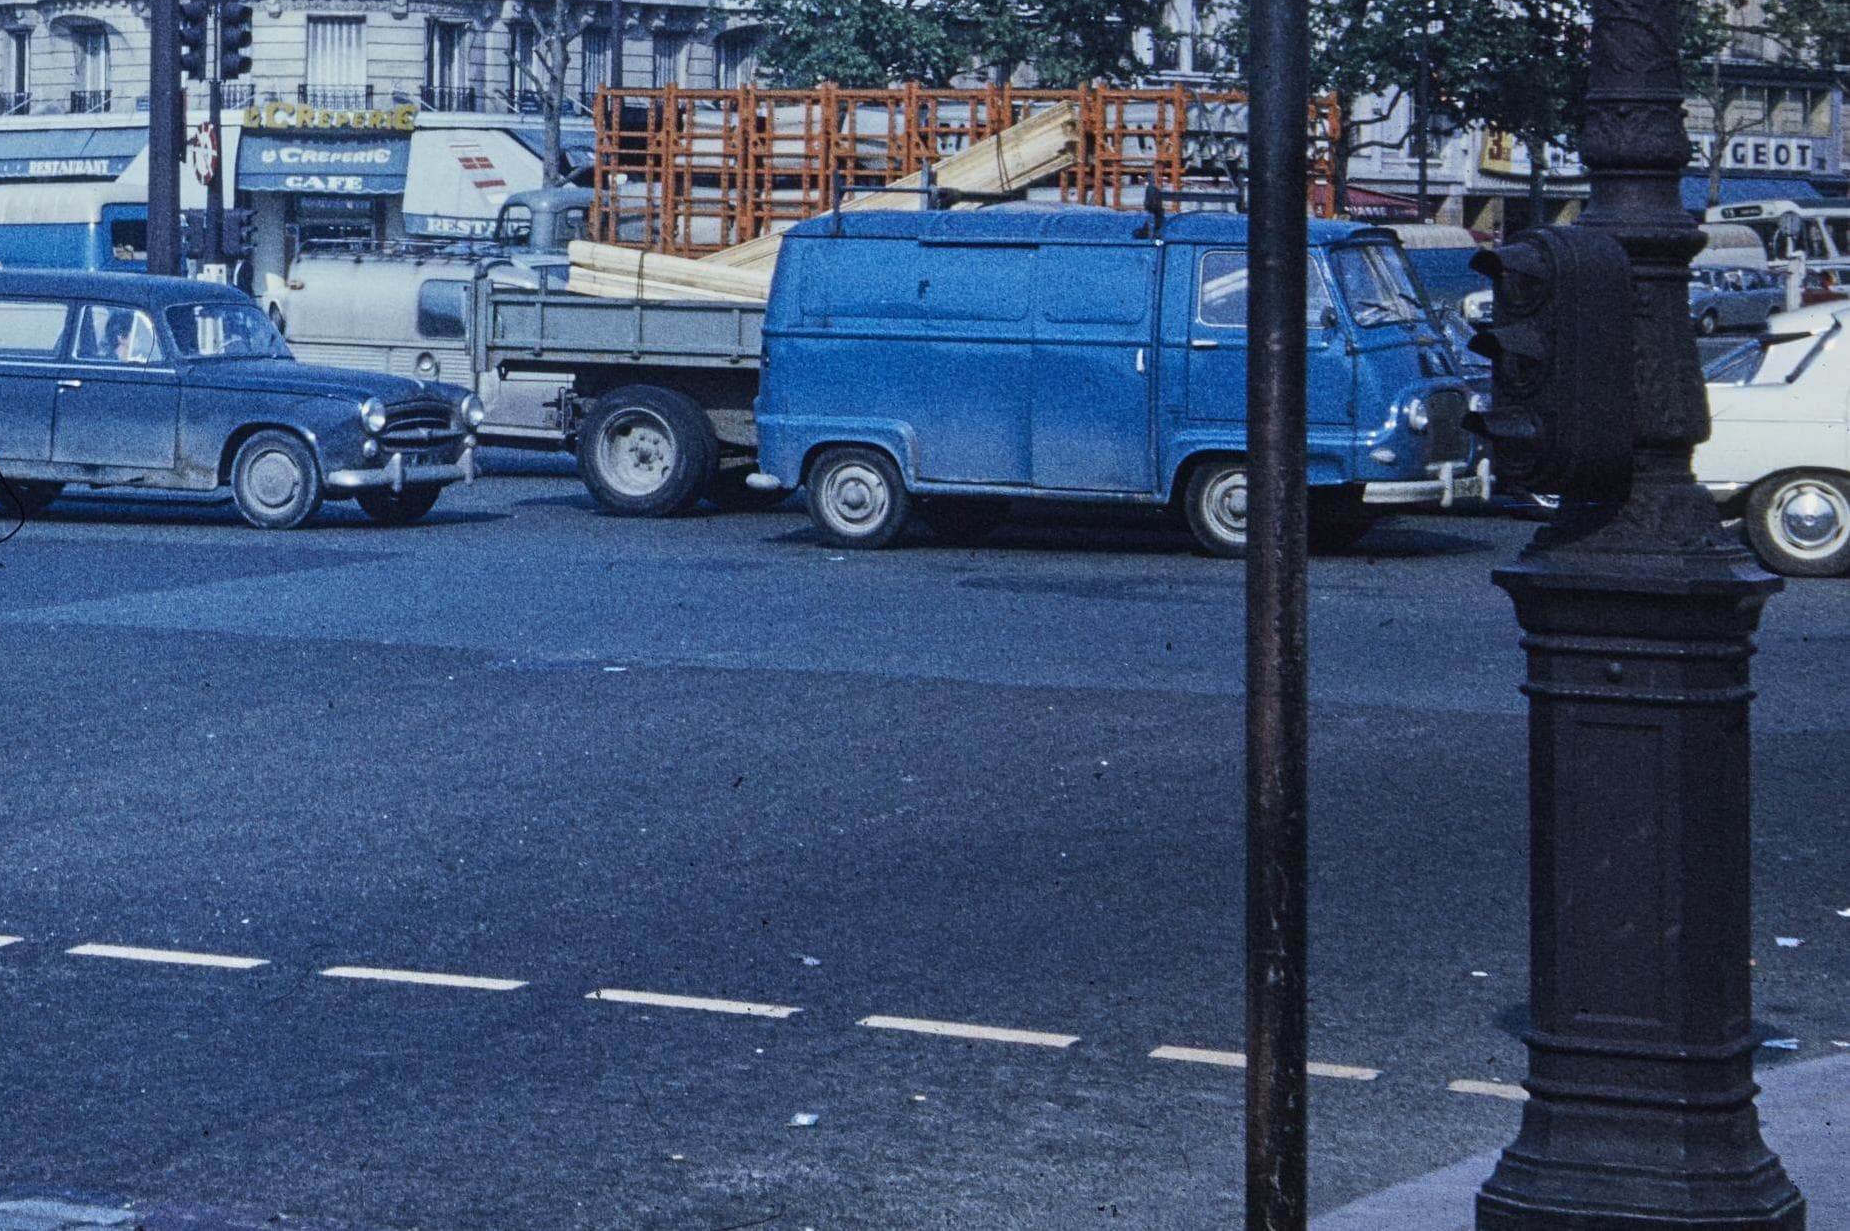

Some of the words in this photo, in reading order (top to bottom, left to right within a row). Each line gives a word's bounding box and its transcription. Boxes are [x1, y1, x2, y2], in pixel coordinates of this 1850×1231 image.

[1690, 141, 1811, 167] EGEOT
[28, 159, 110, 175] RESTAURANT
[285, 175, 363, 191] CAFE
